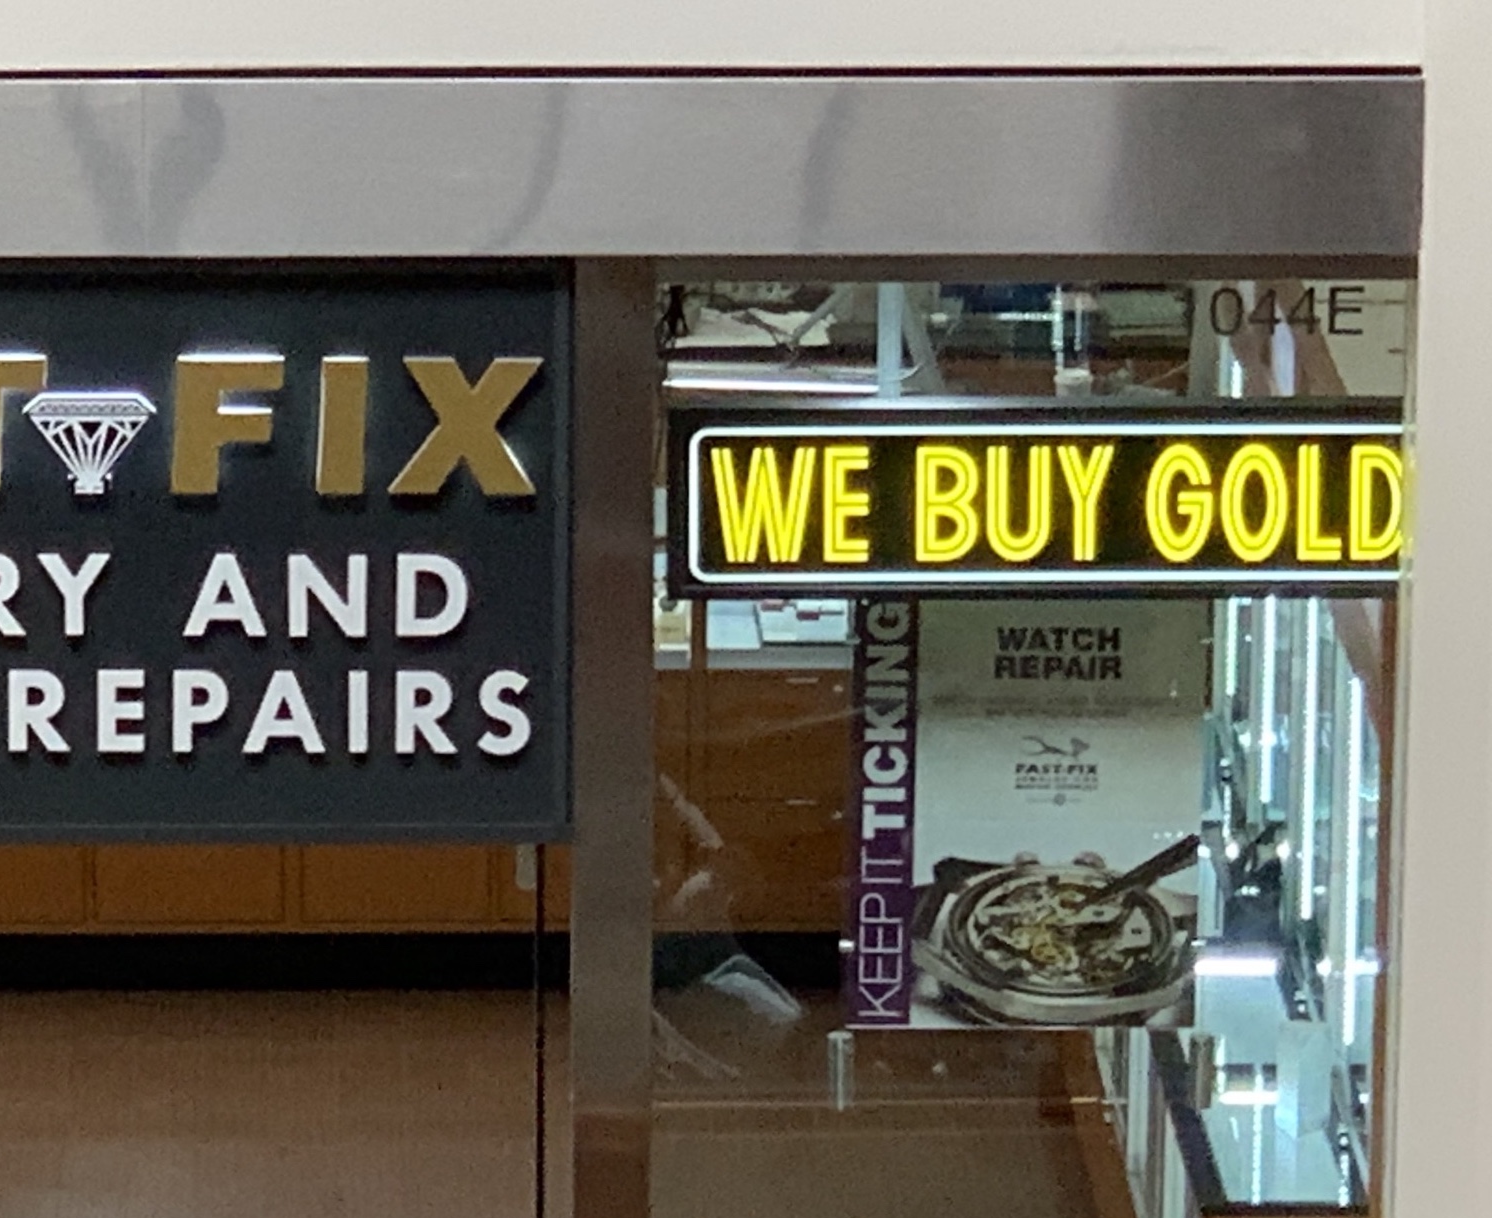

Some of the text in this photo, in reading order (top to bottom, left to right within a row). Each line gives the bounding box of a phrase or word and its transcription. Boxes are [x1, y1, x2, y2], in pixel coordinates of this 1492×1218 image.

[1209, 286, 1365, 336] 044E
[169, 351, 544, 497] FIX
[710, 443, 1405, 563] WE BUY GOLD
[182, 552, 469, 639] AND
[997, 627, 1122, 651] WATCH
[994, 655, 1123, 680] REPAIR
[6, 667, 533, 757] REPAIRS
[858, 602, 910, 1018] KEEP IT TICKING
